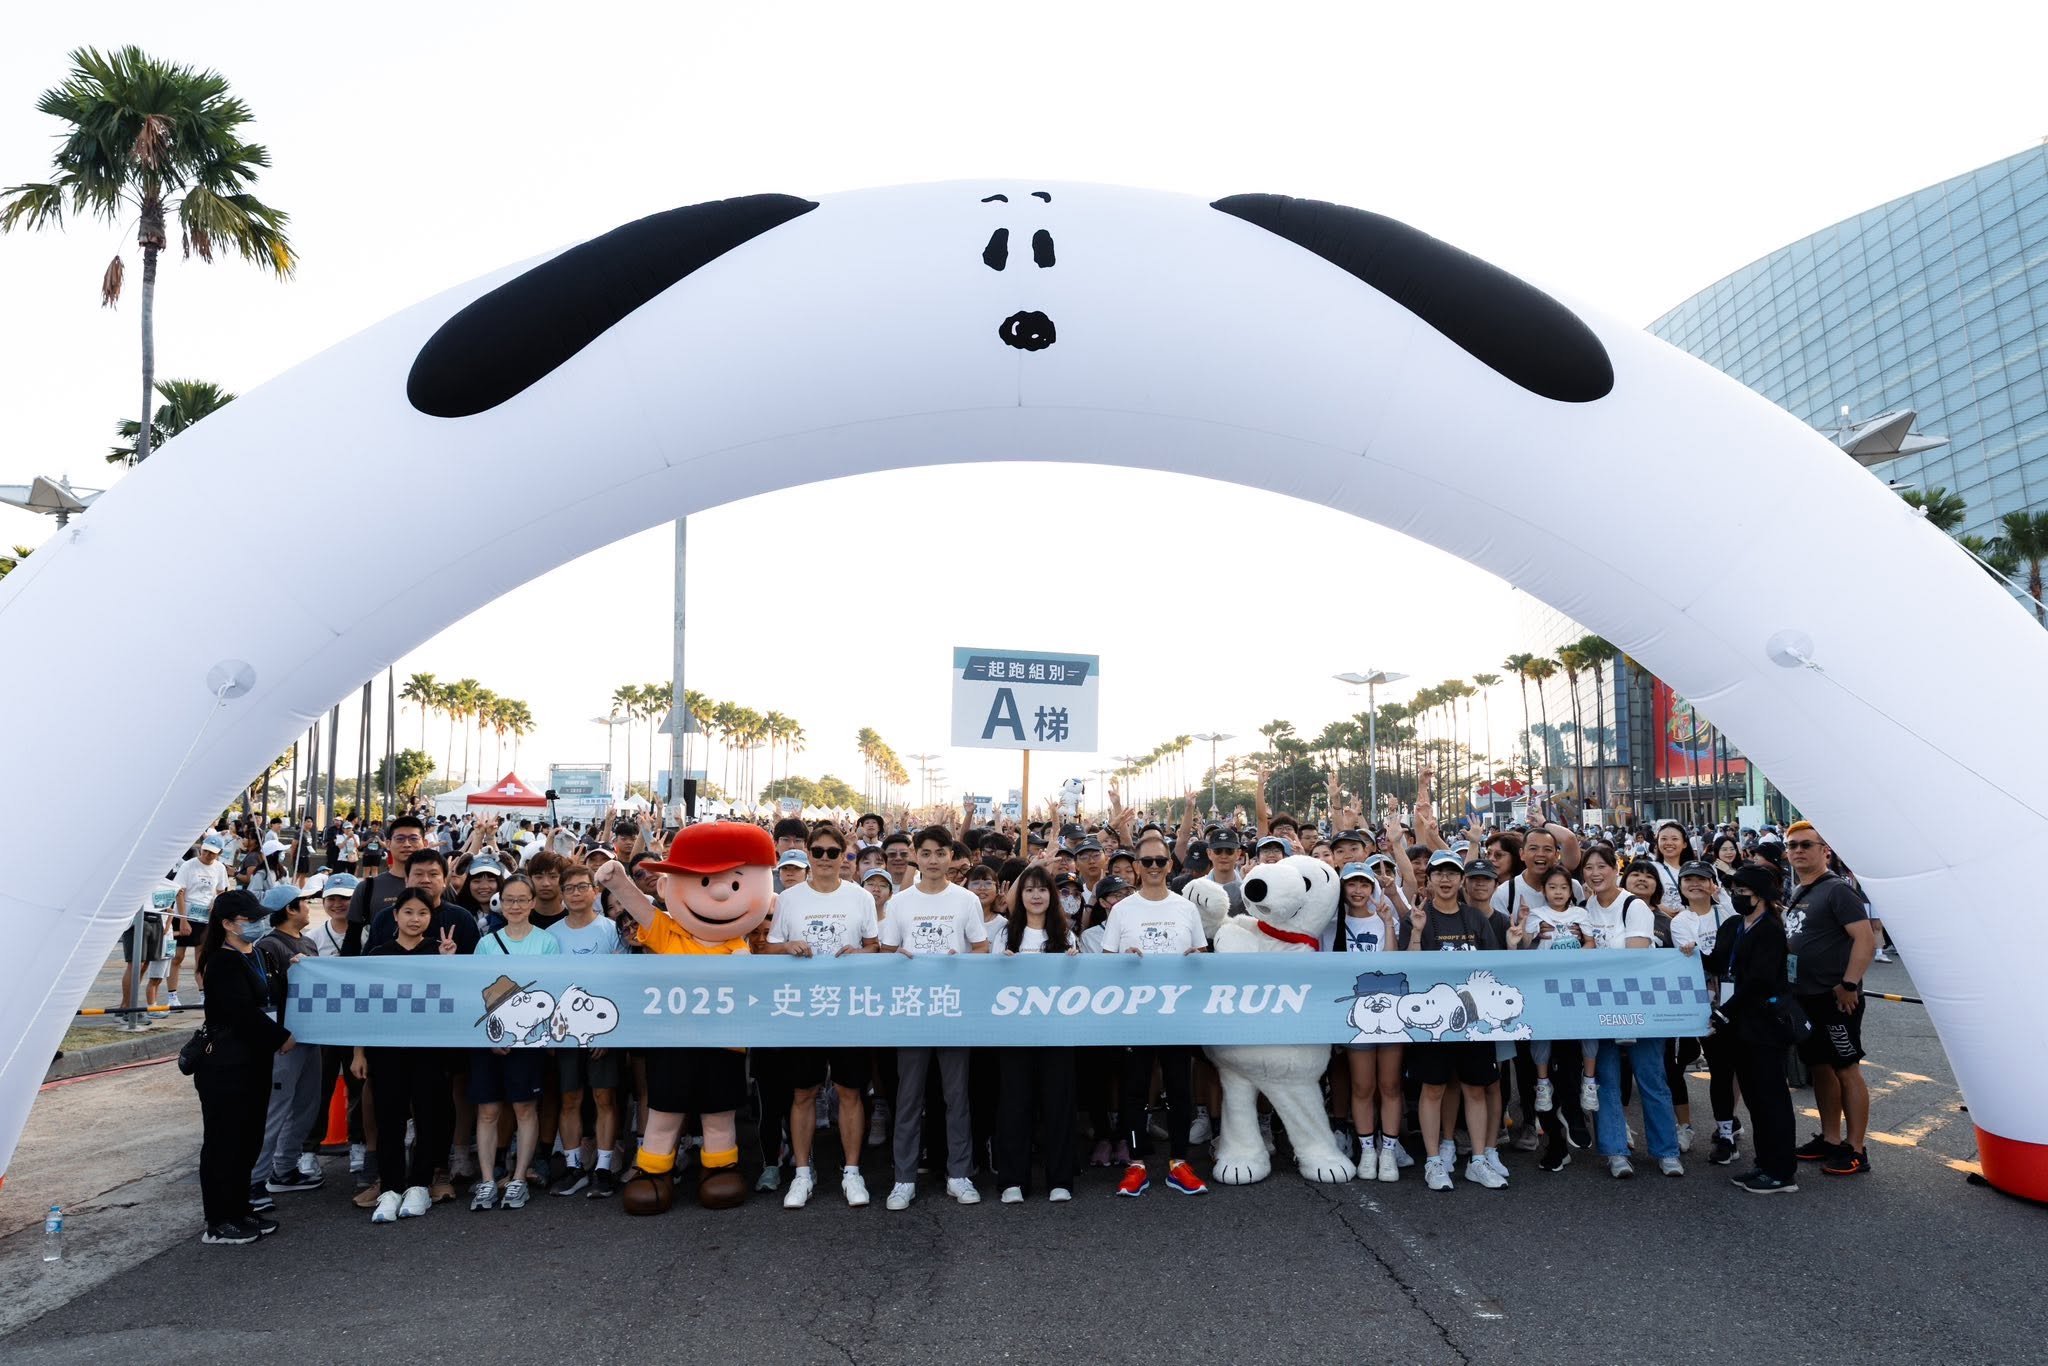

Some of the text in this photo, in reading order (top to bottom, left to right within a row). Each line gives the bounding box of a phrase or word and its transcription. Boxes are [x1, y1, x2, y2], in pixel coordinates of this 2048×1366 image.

[988, 661, 1065, 681] 起跑組別
[643, 984, 1312, 1017] 2025 史努比路跑 SNOOPY RUN
[1599, 1013, 1645, 1026] PEANUTS
